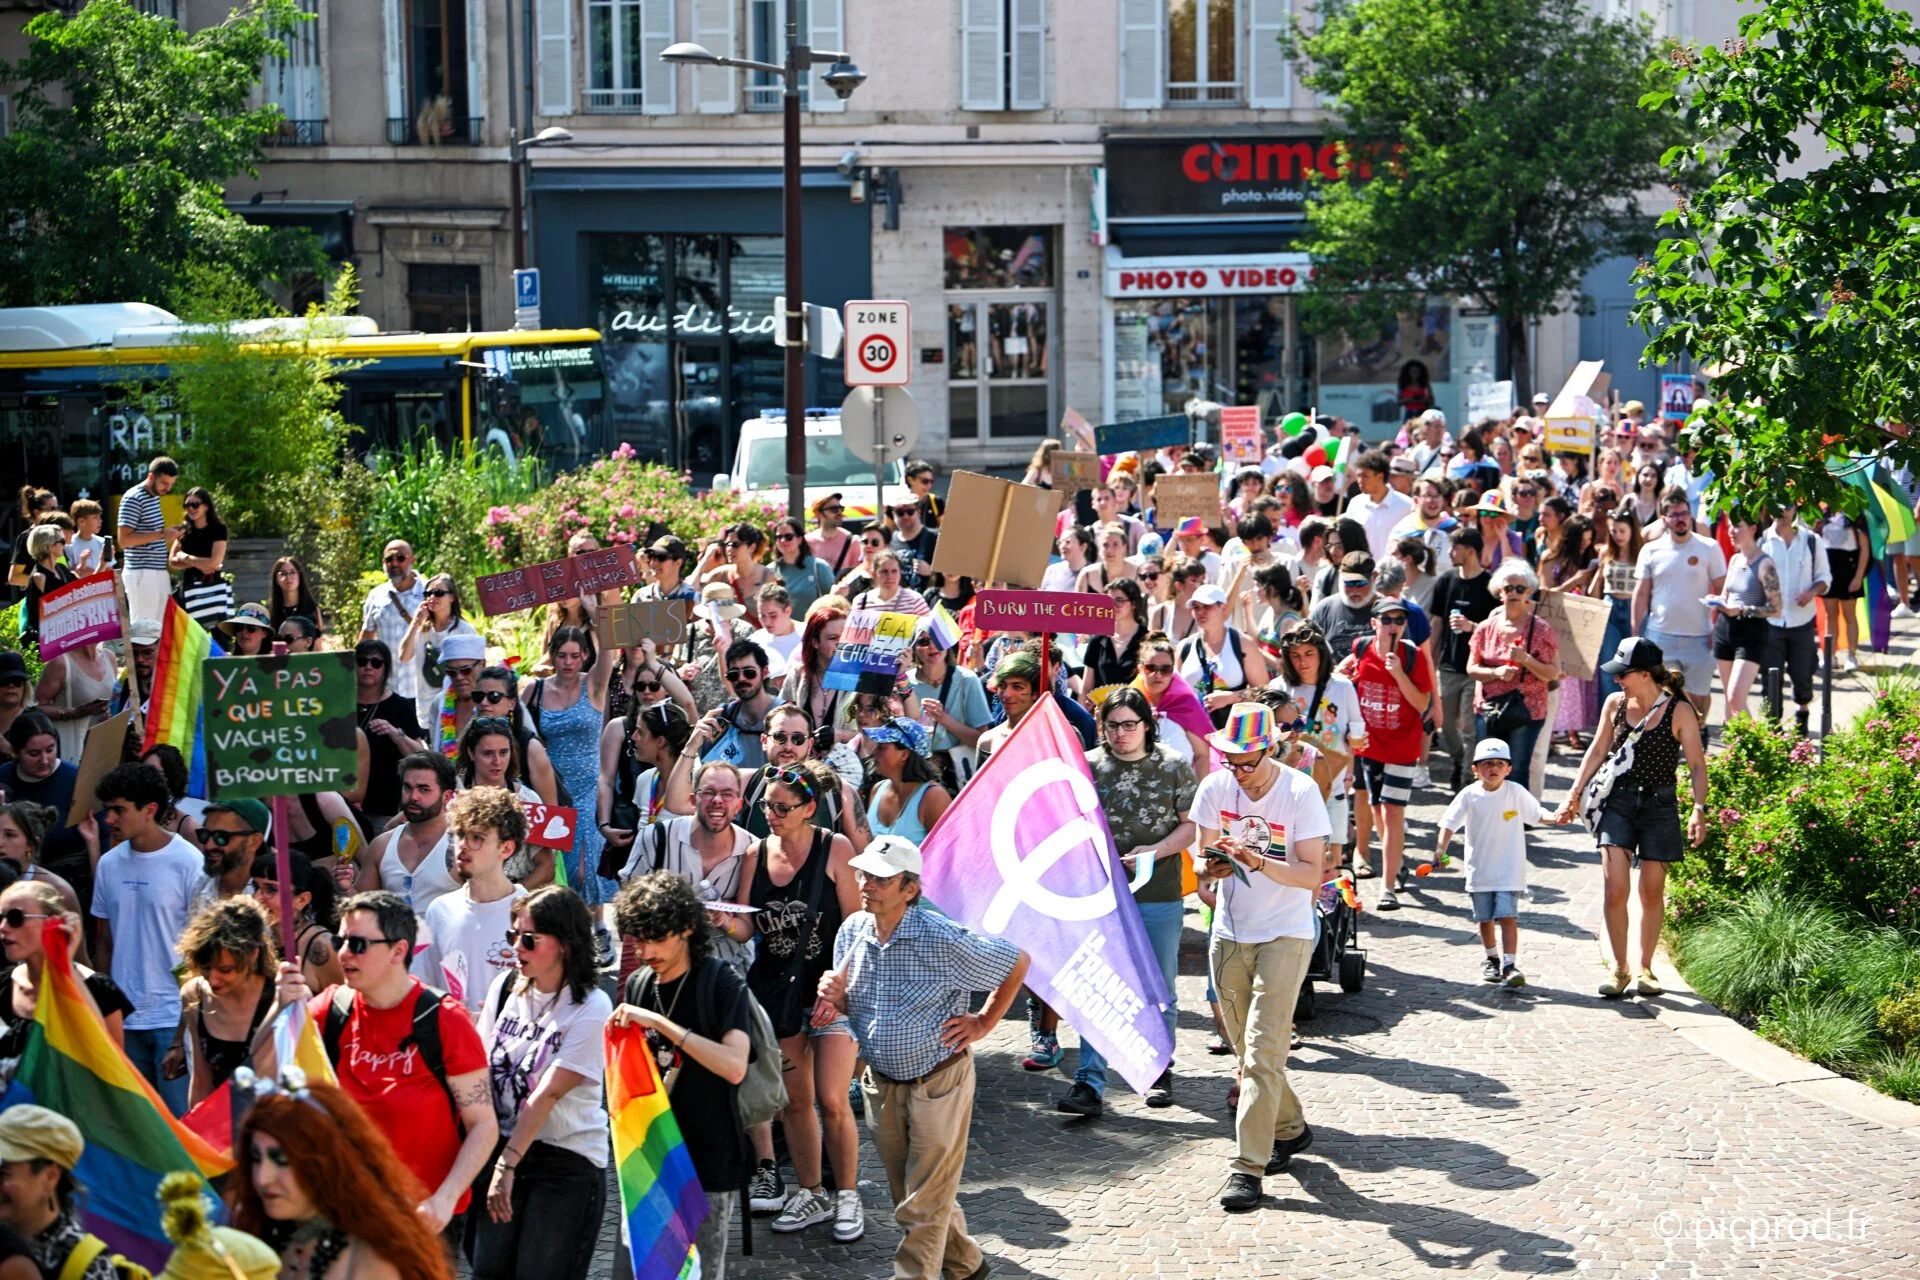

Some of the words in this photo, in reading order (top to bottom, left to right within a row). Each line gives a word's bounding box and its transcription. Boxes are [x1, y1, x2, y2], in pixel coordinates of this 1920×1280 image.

[523, 275, 532, 294] P
[1120, 269, 1207, 290] PHOTO
[1219, 267, 1297, 288] VIDEO
[857, 312, 897, 323] ZONE
[866, 345, 889, 362] 30
[484, 570, 525, 592] QUEER
[542, 564, 565, 580] DES
[579, 552, 619, 571] VILLES
[506, 590, 538, 610] QUEER
[547, 586, 566, 599] DES
[574, 568, 629, 593] CHAMPS
[983, 599, 1027, 616] BURN
[1032, 602, 1056, 616] THE
[845, 615, 893, 642] MAKE
[888, 620, 907, 646] A
[275, 667, 323, 690] PAS
[228, 700, 273, 723] QUE
[284, 697, 324, 717] LES
[213, 725, 307, 751] VACHES
[216, 766, 340, 786] BROUTENT
[1085, 929, 1107, 953] LA
[1064, 944, 1145, 1024] FRANCE
[1050, 968, 1159, 1073] INSOUMISE
